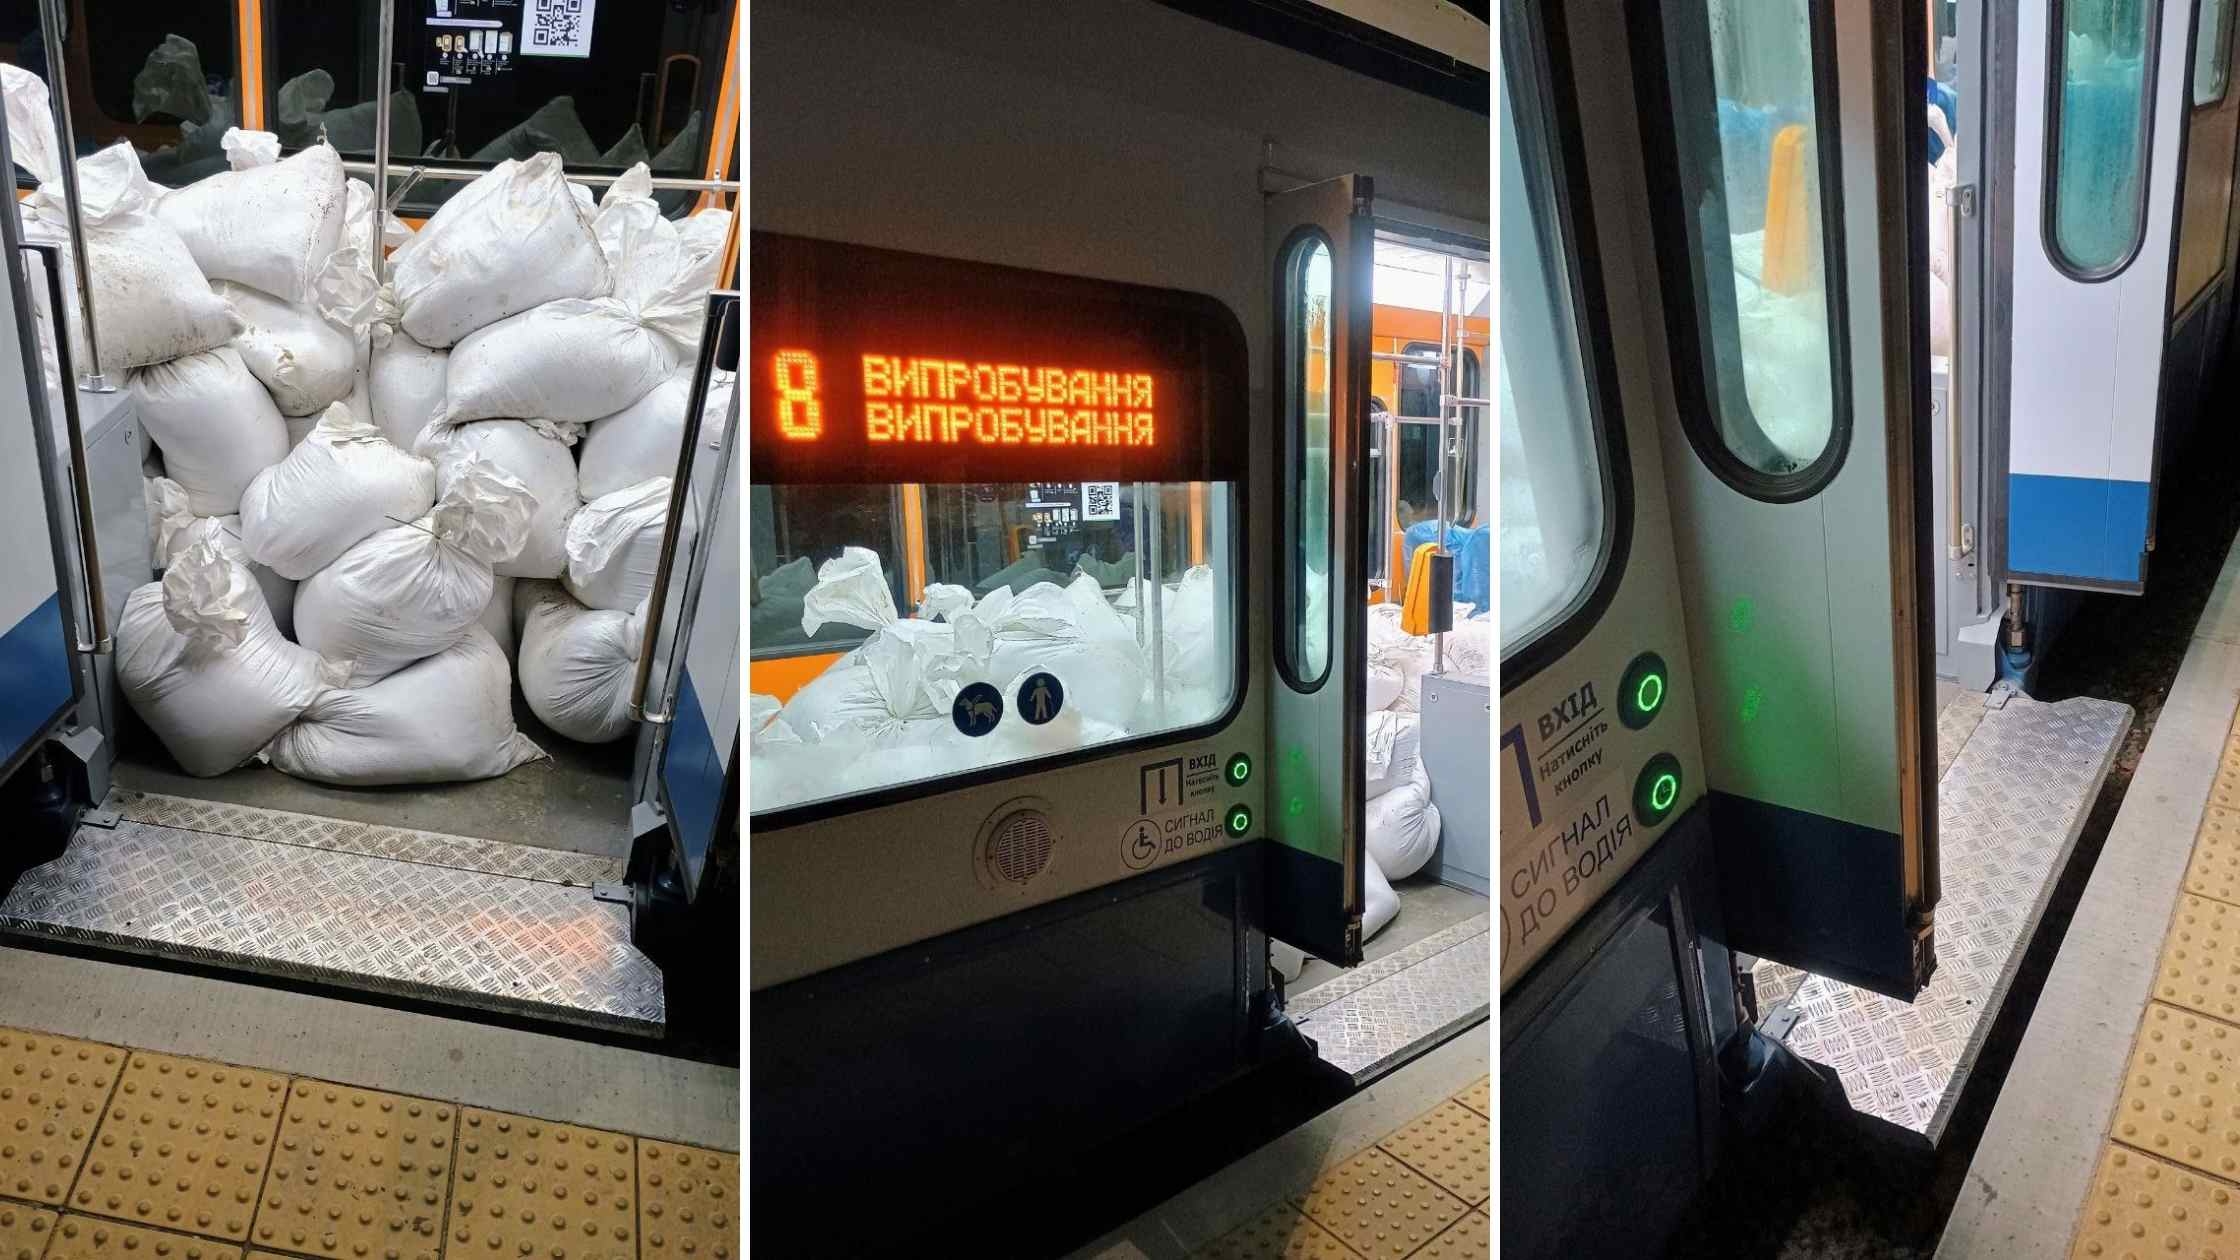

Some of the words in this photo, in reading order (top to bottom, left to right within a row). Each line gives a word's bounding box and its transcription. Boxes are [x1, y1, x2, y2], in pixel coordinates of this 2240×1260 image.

[774, 350, 823, 440] 8
[861, 354, 1153, 408] ВИПРОБУВАННЯ
[865, 402, 1153, 446] ВИПРОБУВАННЯ
[1537, 681, 1598, 742] ВХІД
[1189, 753, 1217, 770] ВХІД
[1539, 722, 1608, 782] Натисніть
[1553, 747, 1603, 796] кнопку
[1164, 808, 1214, 833] СИГНАЛ
[1164, 835, 1183, 855] ДО
[1186, 824, 1224, 846] ВОДІЯ
[1511, 795, 1610, 899] СИГНАЛ
[1519, 888, 1557, 945] ДО
[1562, 814, 1633, 897] ВОДІЯ
